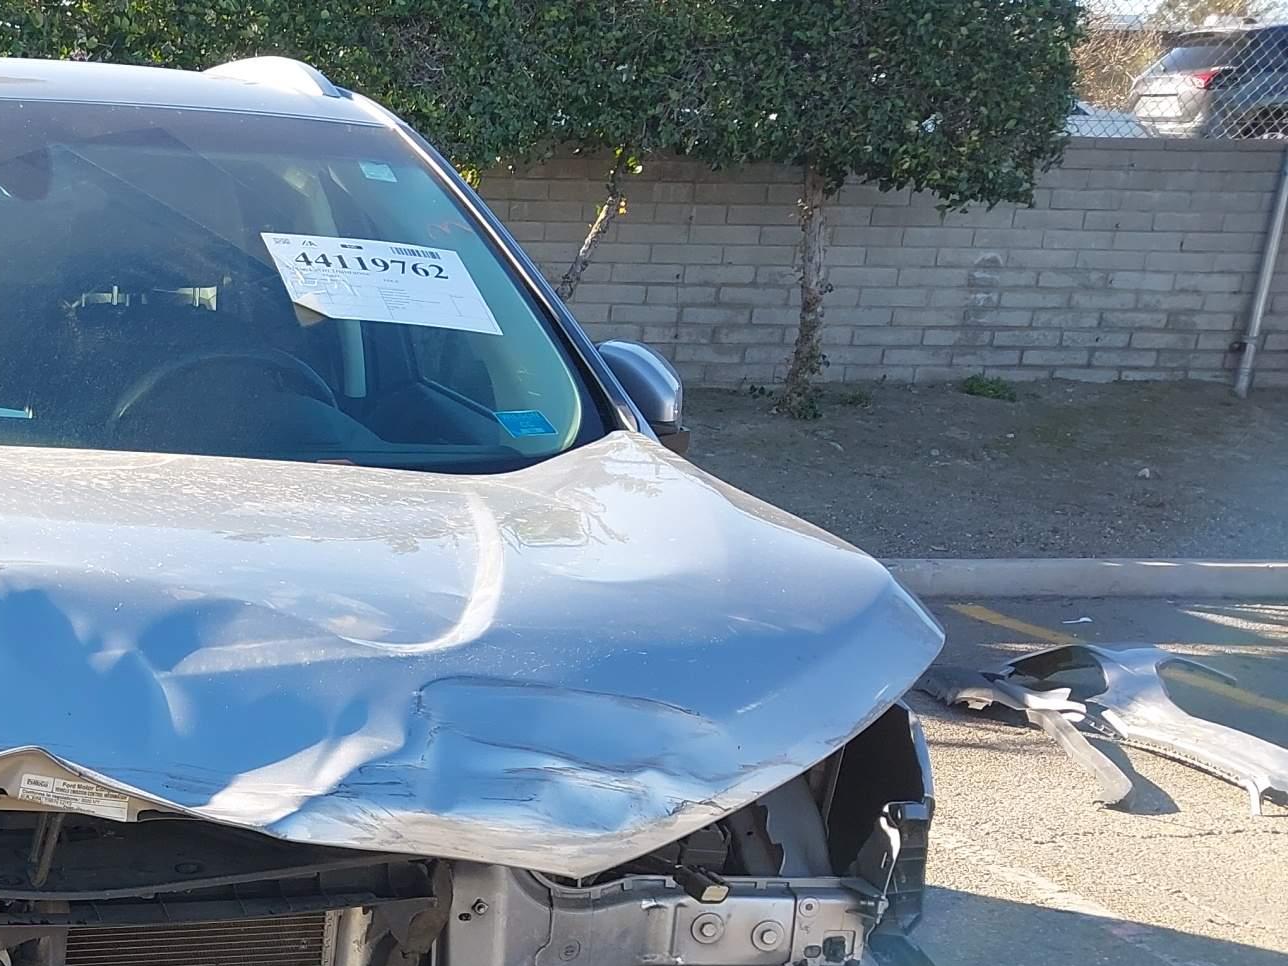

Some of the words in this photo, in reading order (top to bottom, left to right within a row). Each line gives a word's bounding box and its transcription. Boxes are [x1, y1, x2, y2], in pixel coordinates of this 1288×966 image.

[295, 252, 449, 280] 44119762
[62, 781, 77, 789] Ford
[77, 783, 94, 791] Motor
